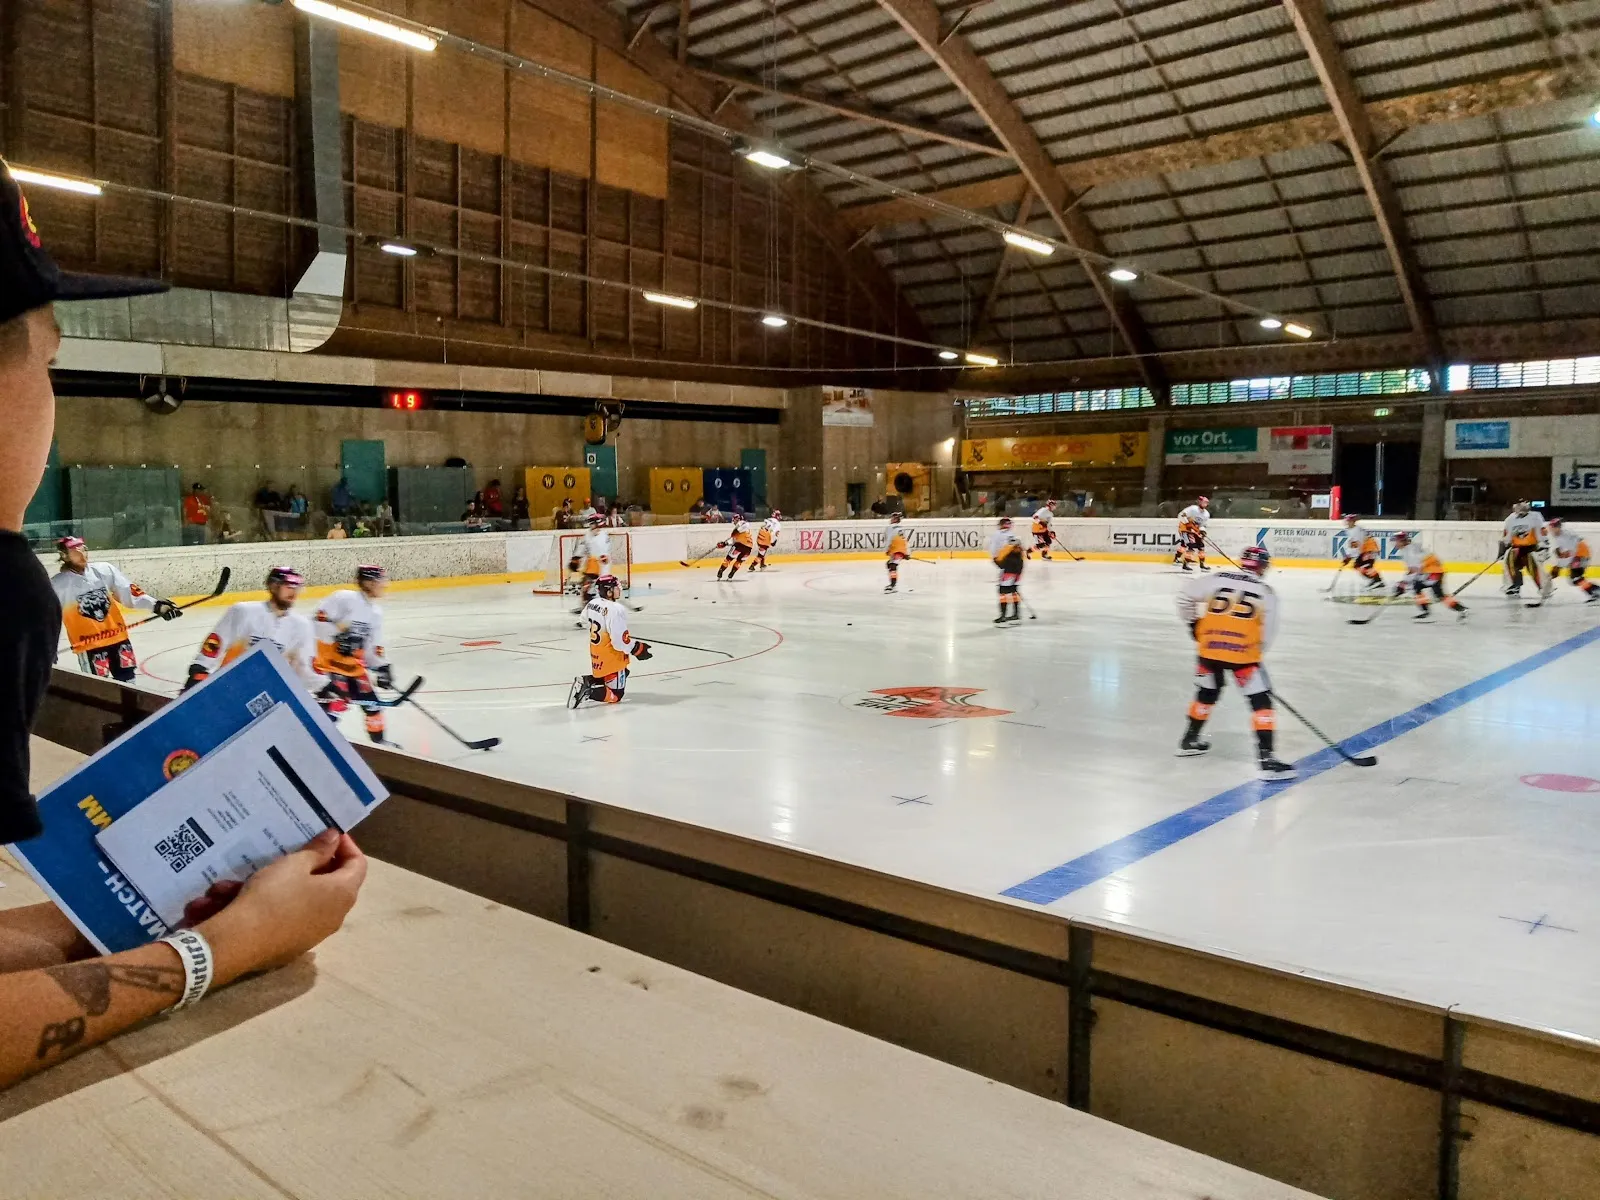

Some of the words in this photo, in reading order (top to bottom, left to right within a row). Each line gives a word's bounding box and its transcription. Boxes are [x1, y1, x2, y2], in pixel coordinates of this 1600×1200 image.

[1174, 434, 1199, 445] vor
[1201, 431, 1233, 445] Ort.
[800, 530, 824, 550] BZ
[828, 529, 887, 550] BERNE
[901, 528, 979, 549] ZEITUNG
[1296, 528, 1316, 537] KÜNZI
[588, 617, 601, 644] 3
[104, 872, 168, 939] MATCH
